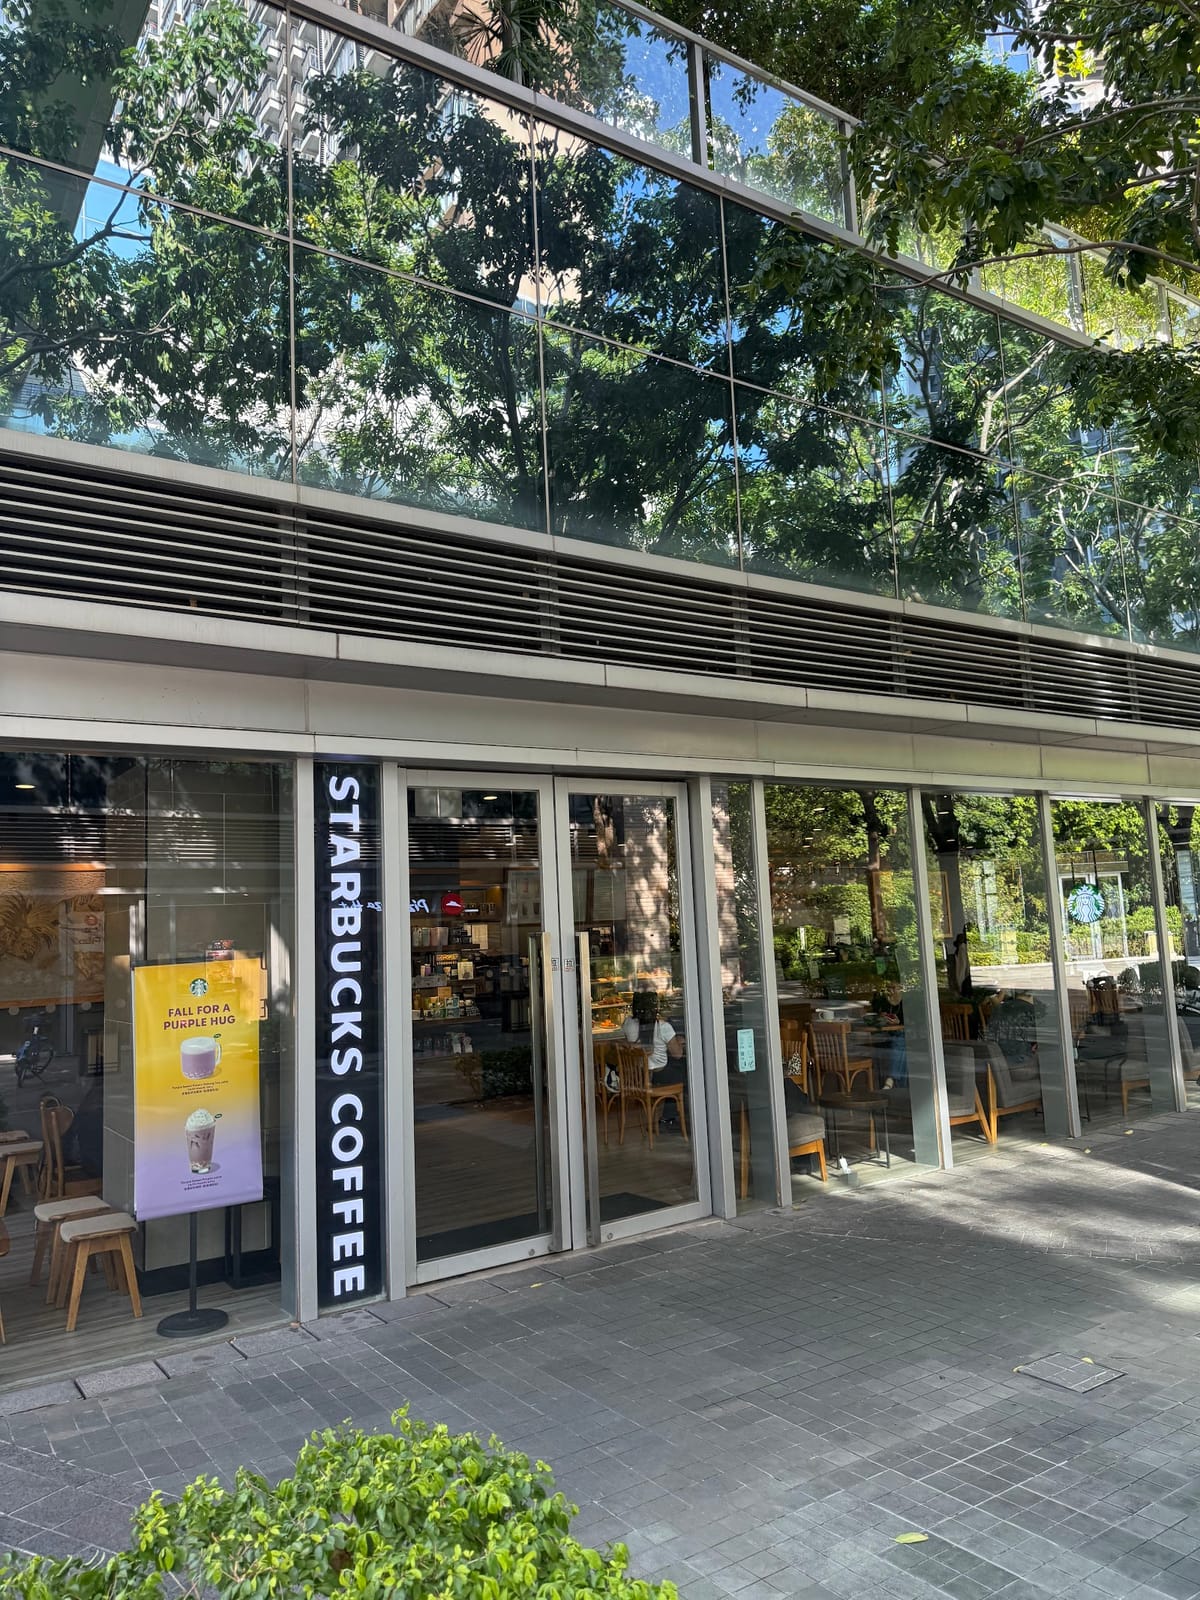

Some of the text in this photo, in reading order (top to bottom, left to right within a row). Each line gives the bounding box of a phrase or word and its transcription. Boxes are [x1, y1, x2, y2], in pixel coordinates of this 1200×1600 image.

[168, 1004, 230, 1017] FALL FOR A
[164, 1015, 236, 1030] PURPLE HUG
[329, 776, 365, 1296] STARBUCKS COFFEE
